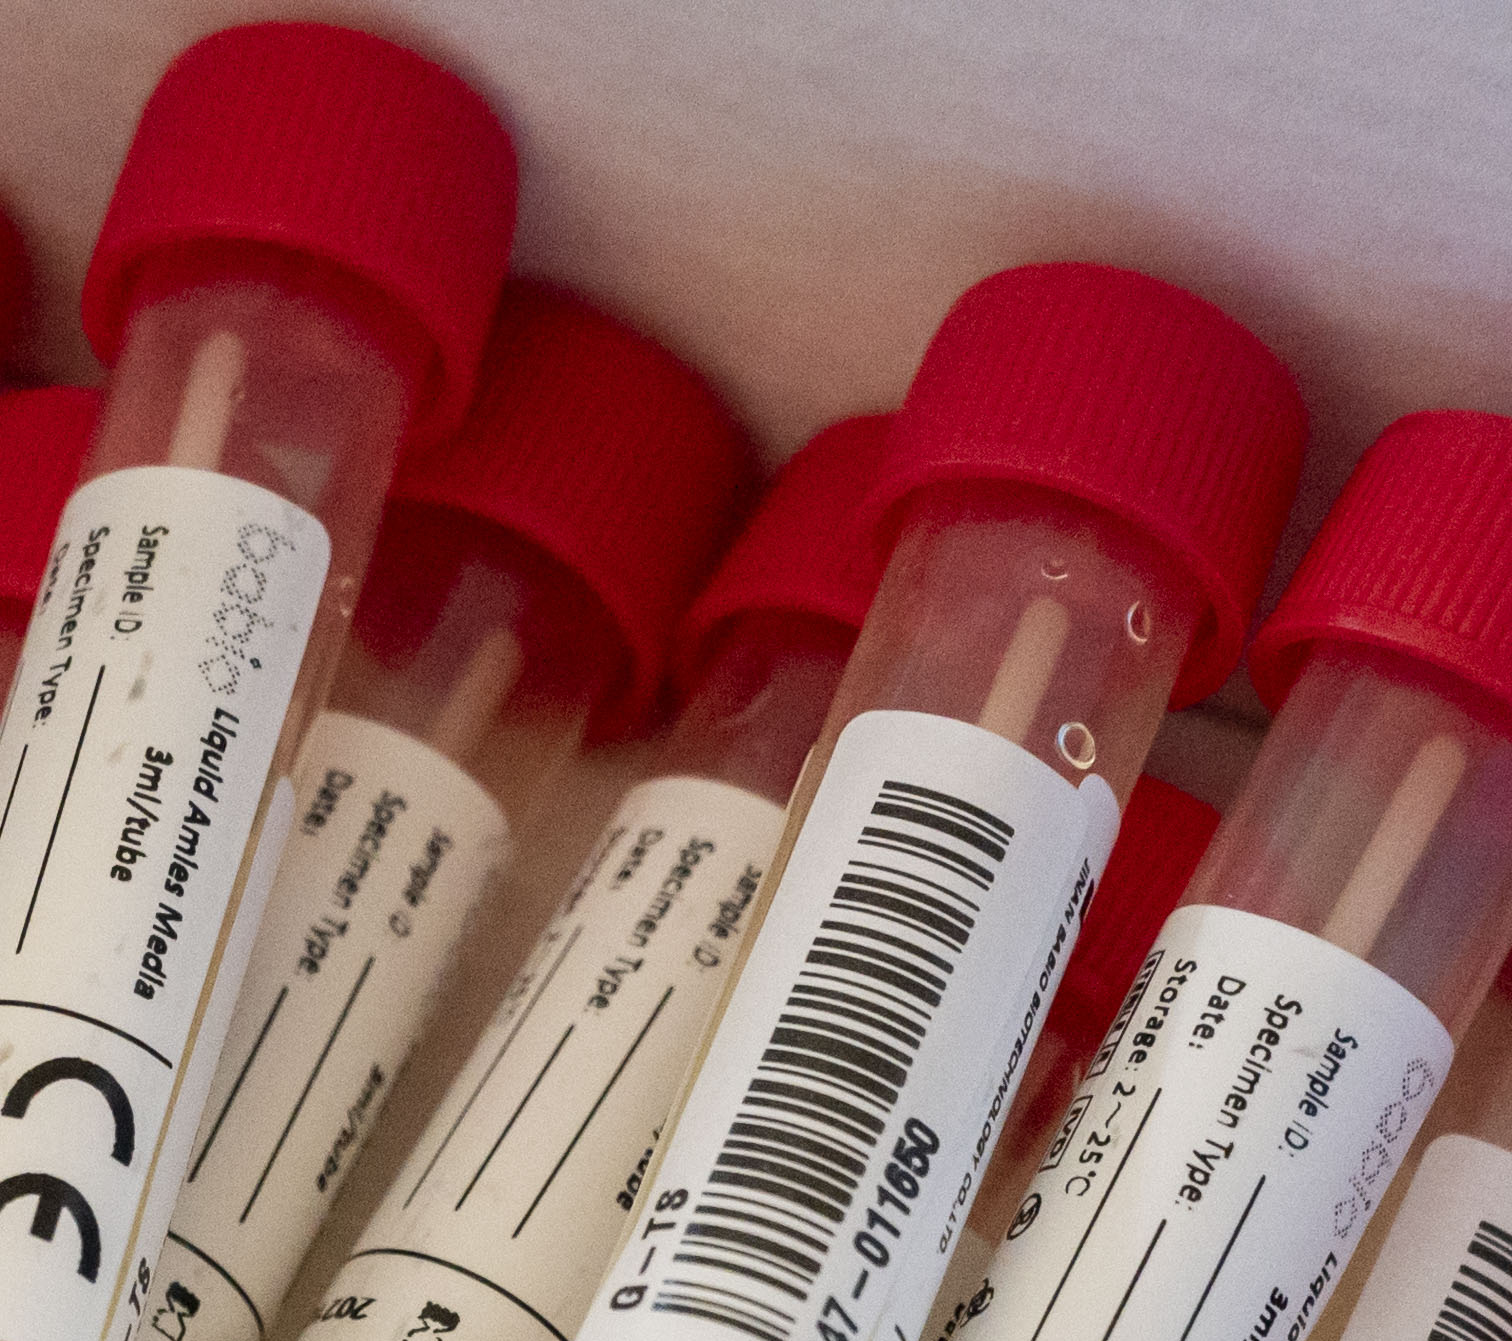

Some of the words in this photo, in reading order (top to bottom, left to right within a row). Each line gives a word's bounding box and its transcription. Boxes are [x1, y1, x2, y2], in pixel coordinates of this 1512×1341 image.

[58, 525, 112, 649] Specimen
[121, 525, 171, 605] Sample
[108, 611, 144, 642] ID:
[28, 652, 75, 729] Type:
[192, 706, 240, 804] Liquid
[299, 766, 354, 836] Date:
[109, 745, 175, 883] 3ml/tube
[163, 800, 212, 898] Amies
[337, 790, 407, 910] Specimen
[634, 837, 716, 948] Specimen
[133, 901, 184, 1001] Media
[582, 950, 645, 1018] Type:
[1121, 954, 1200, 1072] Storage:
[1184, 972, 1248, 1054] Date:
[1220, 993, 1304, 1130] Specimen
[1297, 1027, 1360, 1118] Sample
[1172, 1133, 1236, 1210] Type:
[1277, 1120, 1314, 1158] ID:
[608, 1187, 690, 1312] G-TS
